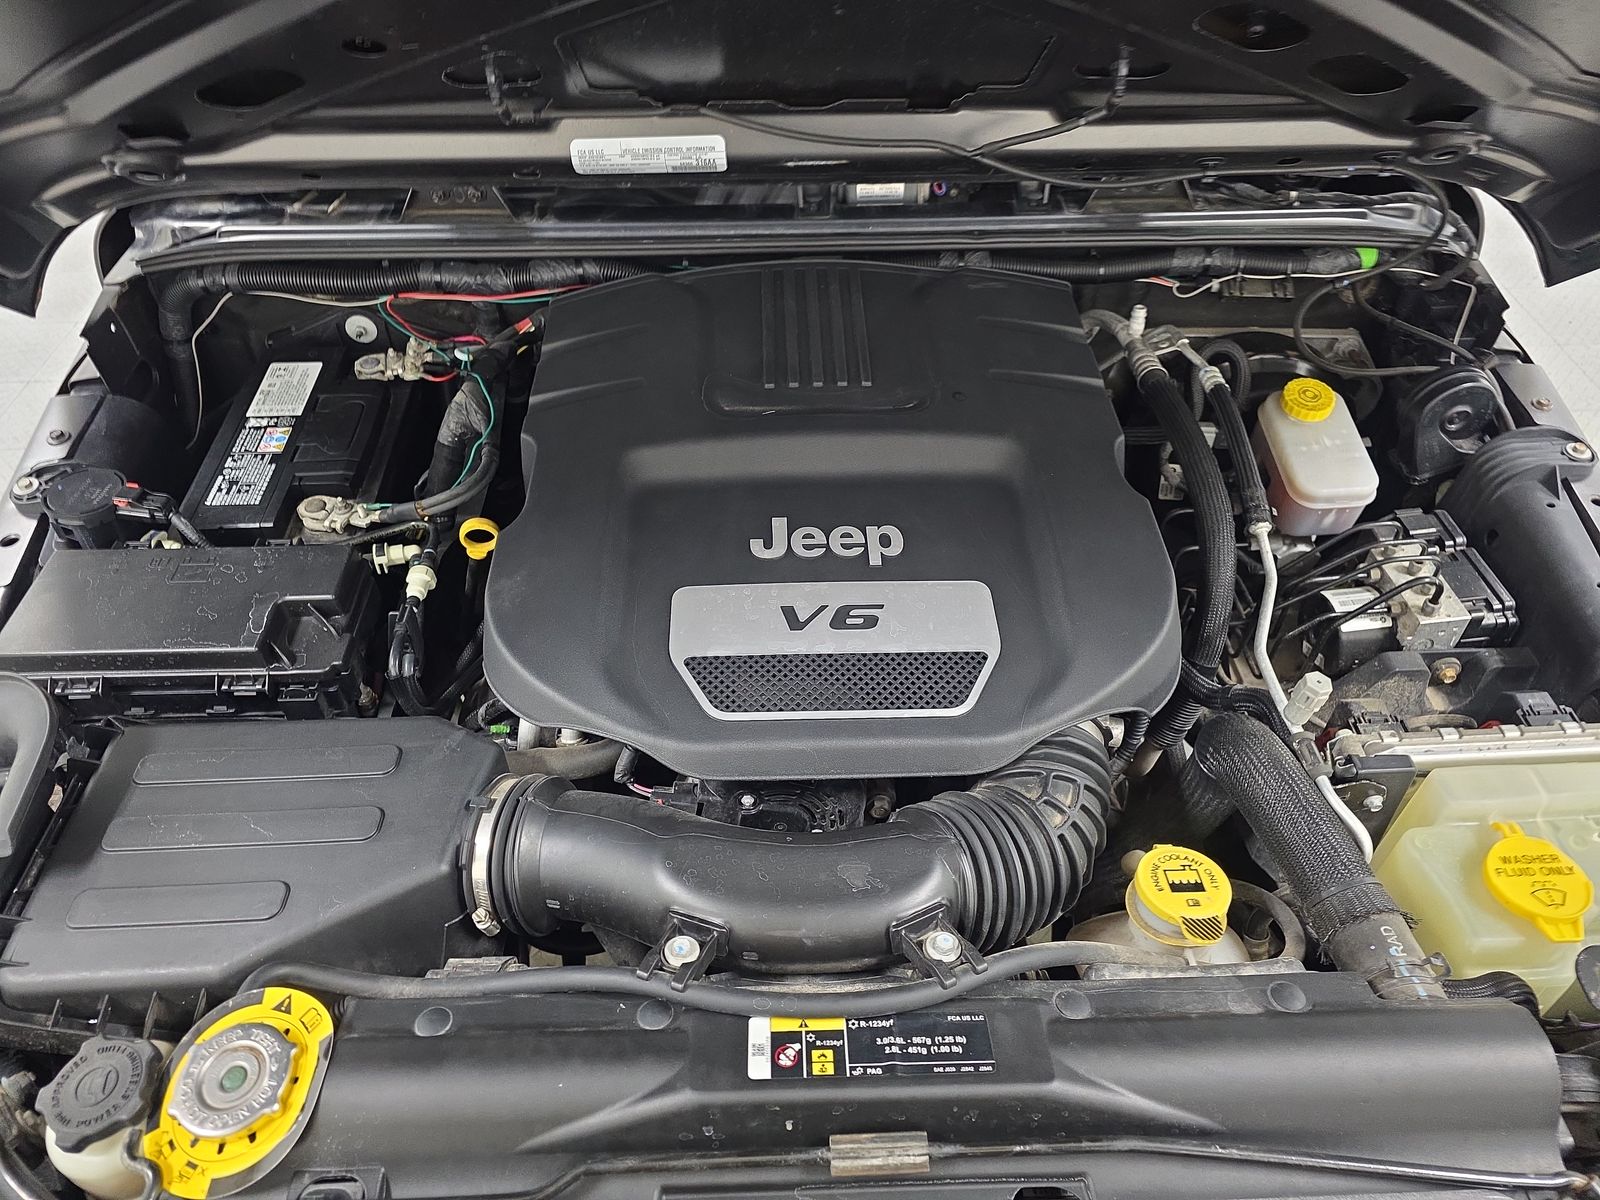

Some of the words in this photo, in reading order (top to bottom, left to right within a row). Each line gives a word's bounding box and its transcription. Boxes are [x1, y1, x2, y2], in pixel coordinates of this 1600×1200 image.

[749, 516, 904, 566] Jeep
[780, 603, 885, 631] V6
[1498, 854, 1561, 864] WASHER
[1151, 863, 1164, 892] ENGINE
[1158, 854, 1204, 867] COOLANT
[1204, 868, 1220, 891] ONLY
[1495, 867, 1537, 877] FLUID
[1539, 866, 1576, 876] ONLY
[1380, 926, 1407, 957] RAD
[860, 1019, 894, 1028] R-1234yf
[935, 1036, 955, 1044] (1.25
[908, 1046, 927, 1055] 451g
[121, 1051, 141, 1101] STEERING
